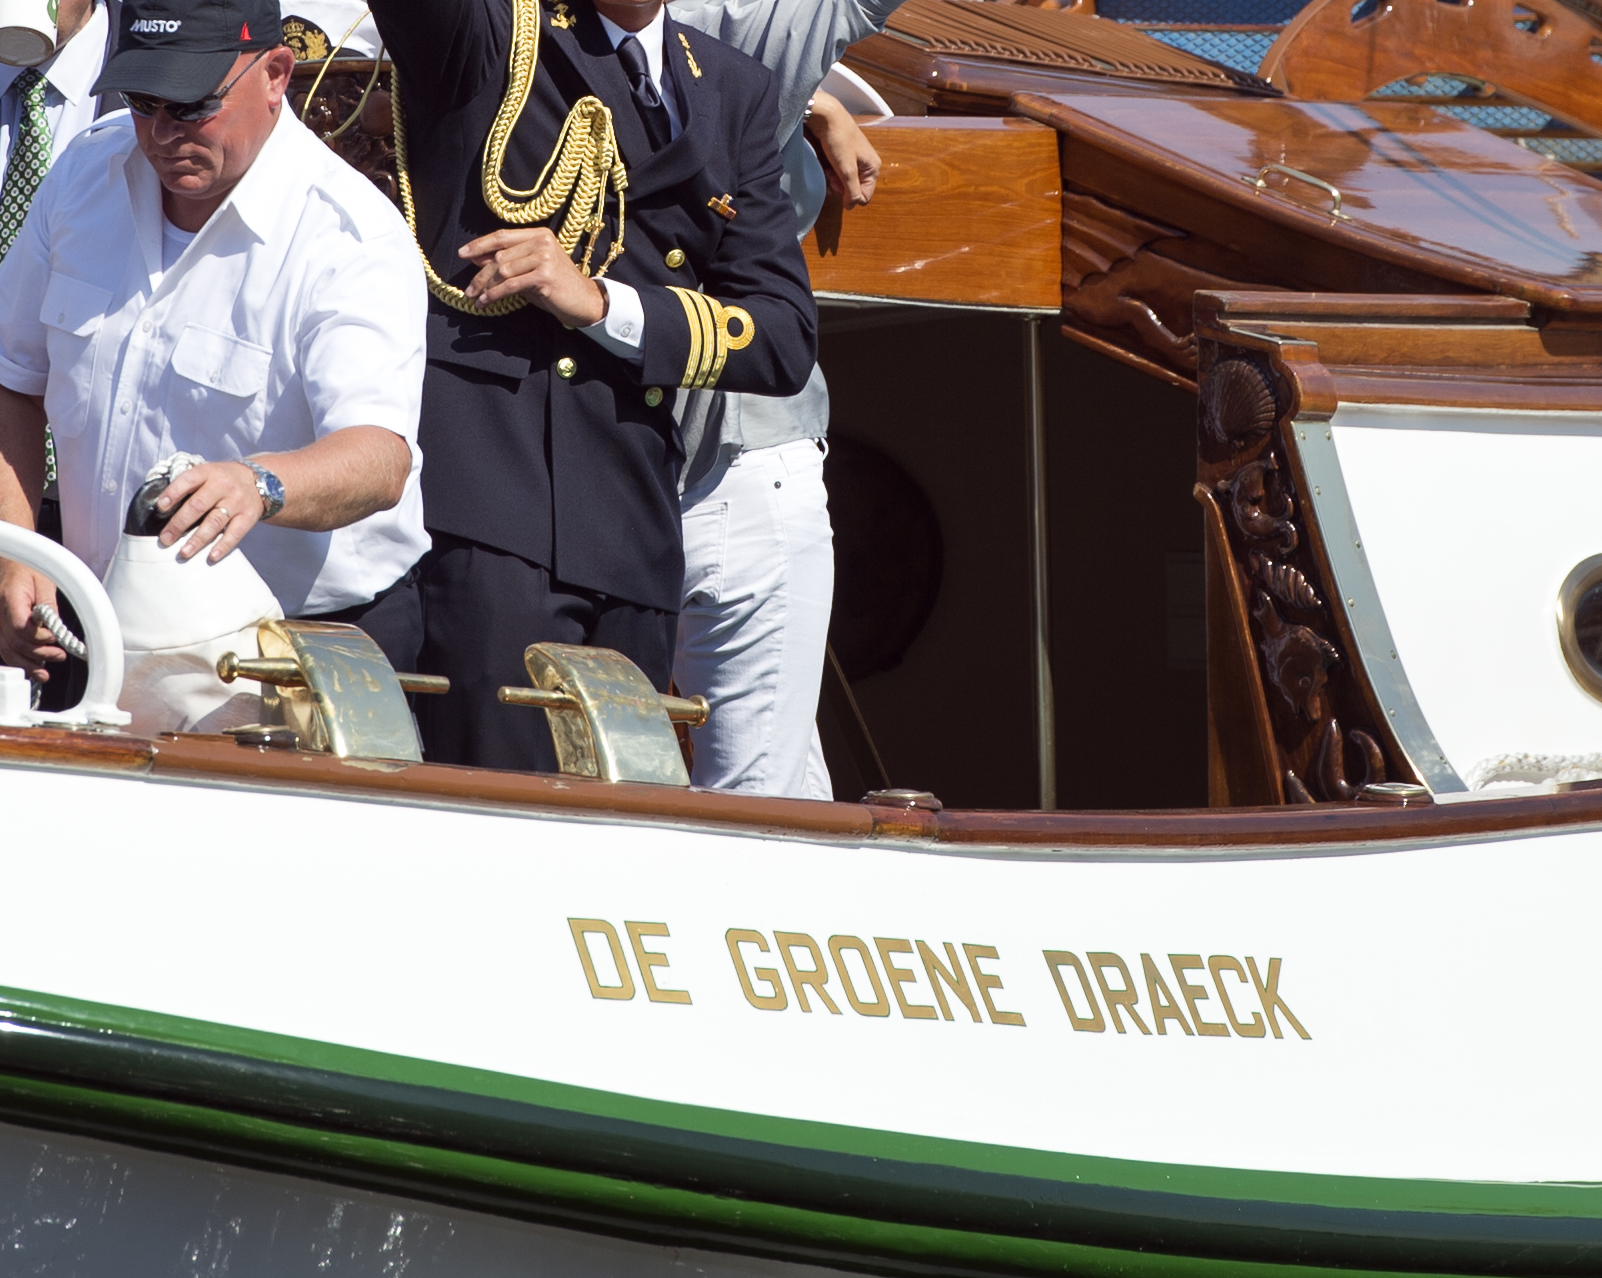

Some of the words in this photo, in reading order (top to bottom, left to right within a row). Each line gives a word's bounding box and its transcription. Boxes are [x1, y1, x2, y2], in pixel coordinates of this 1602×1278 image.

[567, 917, 692, 1005] DE
[725, 927, 1026, 1027] GROENE
[1042, 949, 1312, 1040] DRAECK
